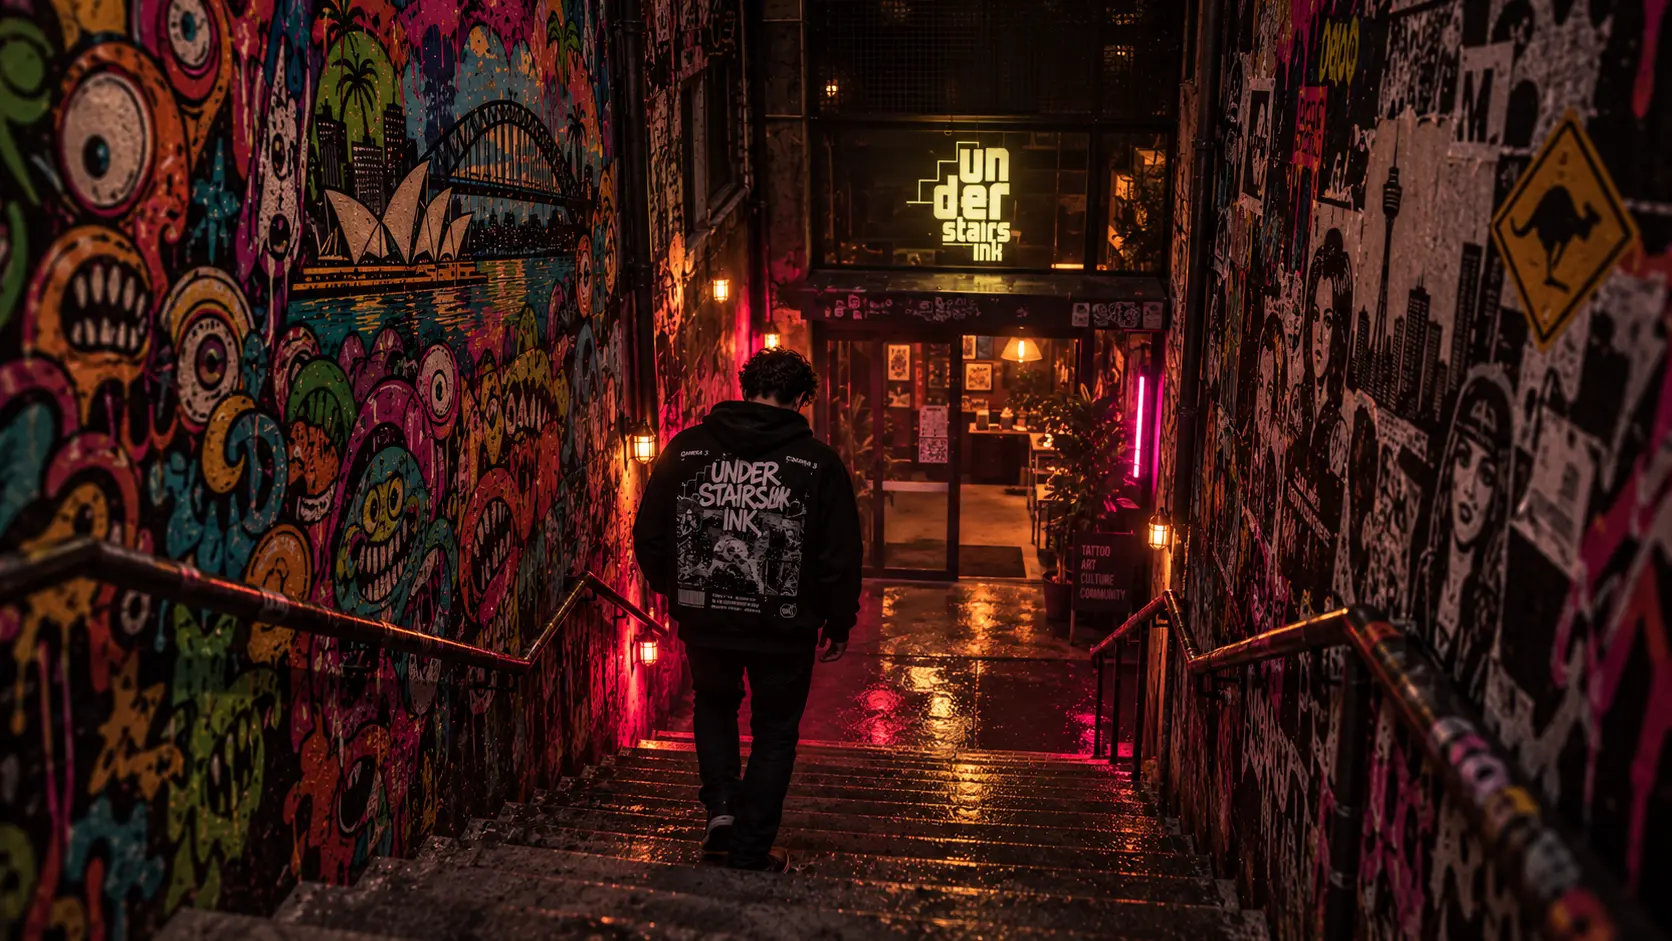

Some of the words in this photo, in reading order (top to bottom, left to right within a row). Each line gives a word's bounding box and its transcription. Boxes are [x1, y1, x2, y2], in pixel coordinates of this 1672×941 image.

[959, 147, 1010, 183] un
[933, 174, 1011, 221] der
[942, 216, 1011, 243] stairs
[711, 457, 782, 486] UNDER
[722, 507, 763, 538] INK
[1080, 558, 1097, 570] ART
[1081, 544, 1111, 558] TATTOO
[1080, 573, 1115, 586] CULTURE
[1079, 587, 1127, 601] COMMUNITY
